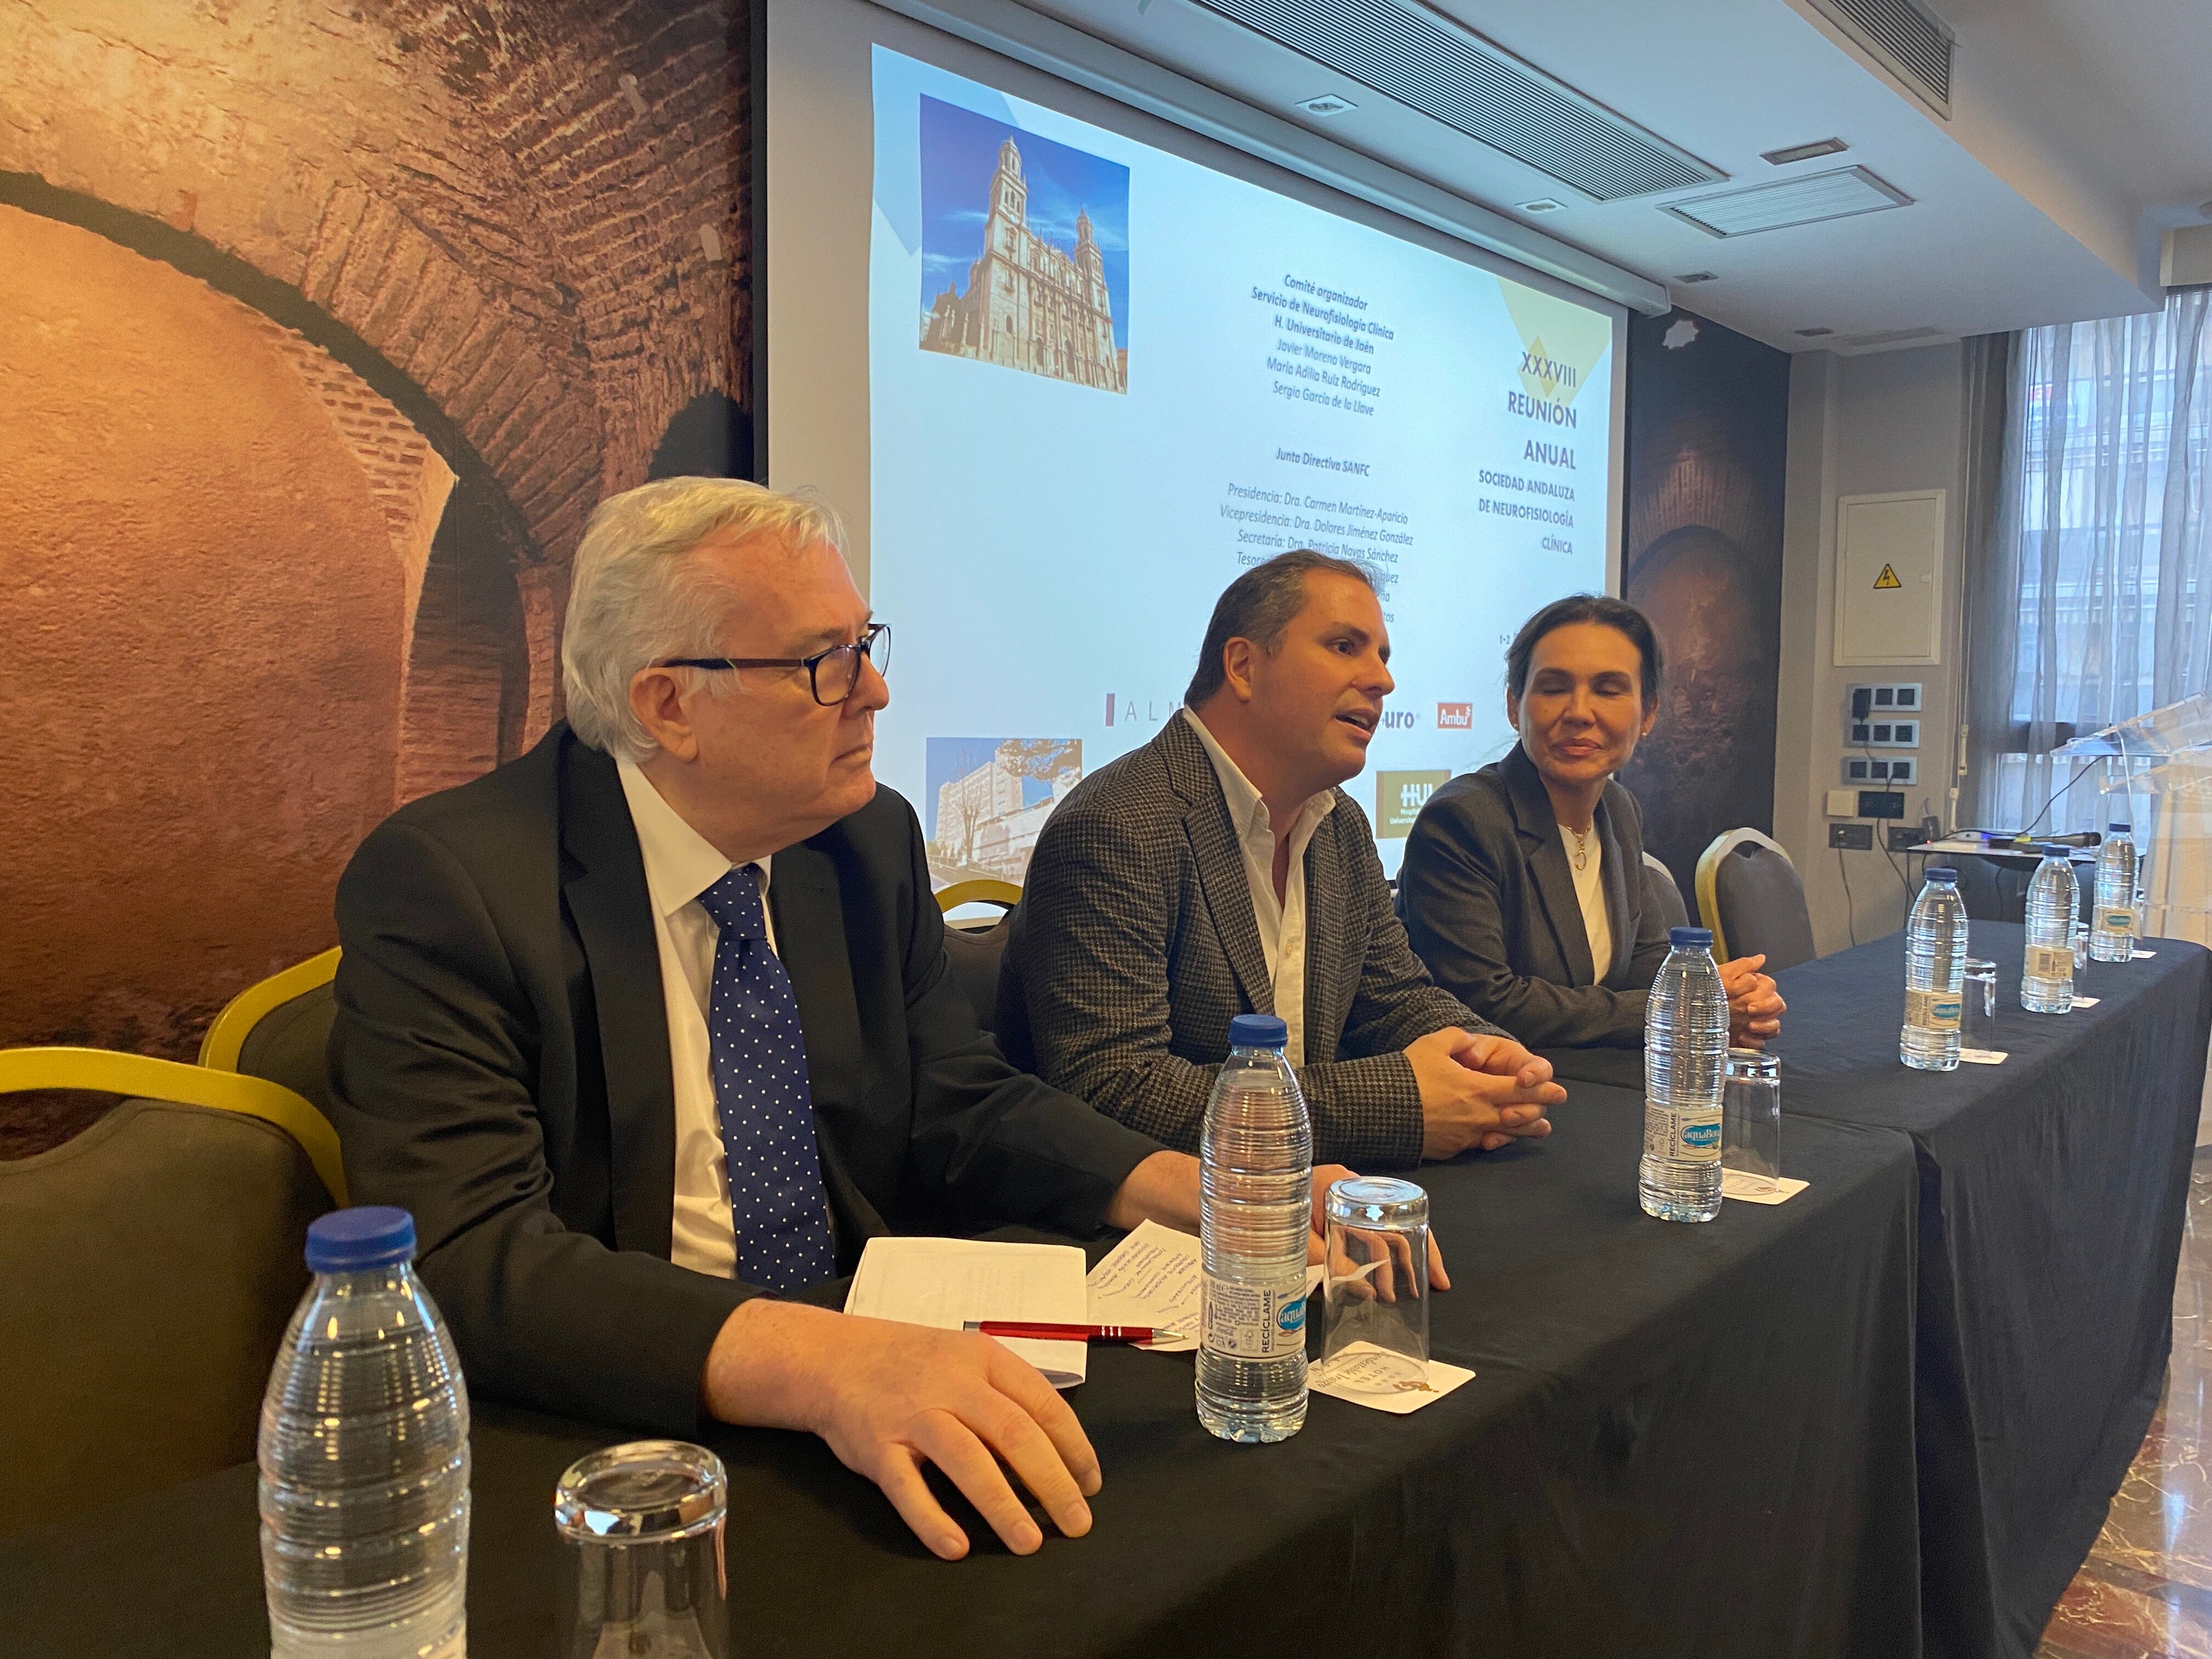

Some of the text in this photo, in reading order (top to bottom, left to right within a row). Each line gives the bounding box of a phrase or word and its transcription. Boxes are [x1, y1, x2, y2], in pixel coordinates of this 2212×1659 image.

[1285, 274, 1368, 311] Comité organizador
[1252, 286, 1394, 341] Servicio de Neurofisiología Clínica
[1275, 314, 1374, 355] H. Universitario de Jaén
[1277, 338, 1371, 374] Javier Moreno Vergara
[1521, 351, 1576, 387] XXXVIII
[1322, 370, 1340, 387] Ruiz
[1273, 381, 1374, 416] Sergio García de la Llave
[1508, 391, 1577, 428] REUNIÓN
[1276, 447, 1370, 477] Junta Directiva SANFC
[1523, 439, 1576, 470] ANUAL
[1228, 483, 1283, 504] Presidencia:
[1284, 492, 1302, 507] Dra.
[1305, 496, 1337, 513] Carmen
[1479, 470, 1575, 502] SOCIEDAD ANDALUZA
[1220, 504, 1414, 546] Vicepresidencia: Dra. Dolores Jiménez González
[1479, 498, 1574, 528] DE NEUROFISIOLOGÍA
[1237, 529, 1285, 548] Secretaría:
[1308, 539, 1340, 555] Patricia
[1341, 543, 1365, 559] Navas
[1367, 547, 1398, 563] Sánchez
[1542, 533, 1573, 555] CLÍNICA
[1440, 708, 1468, 726] Ambu
